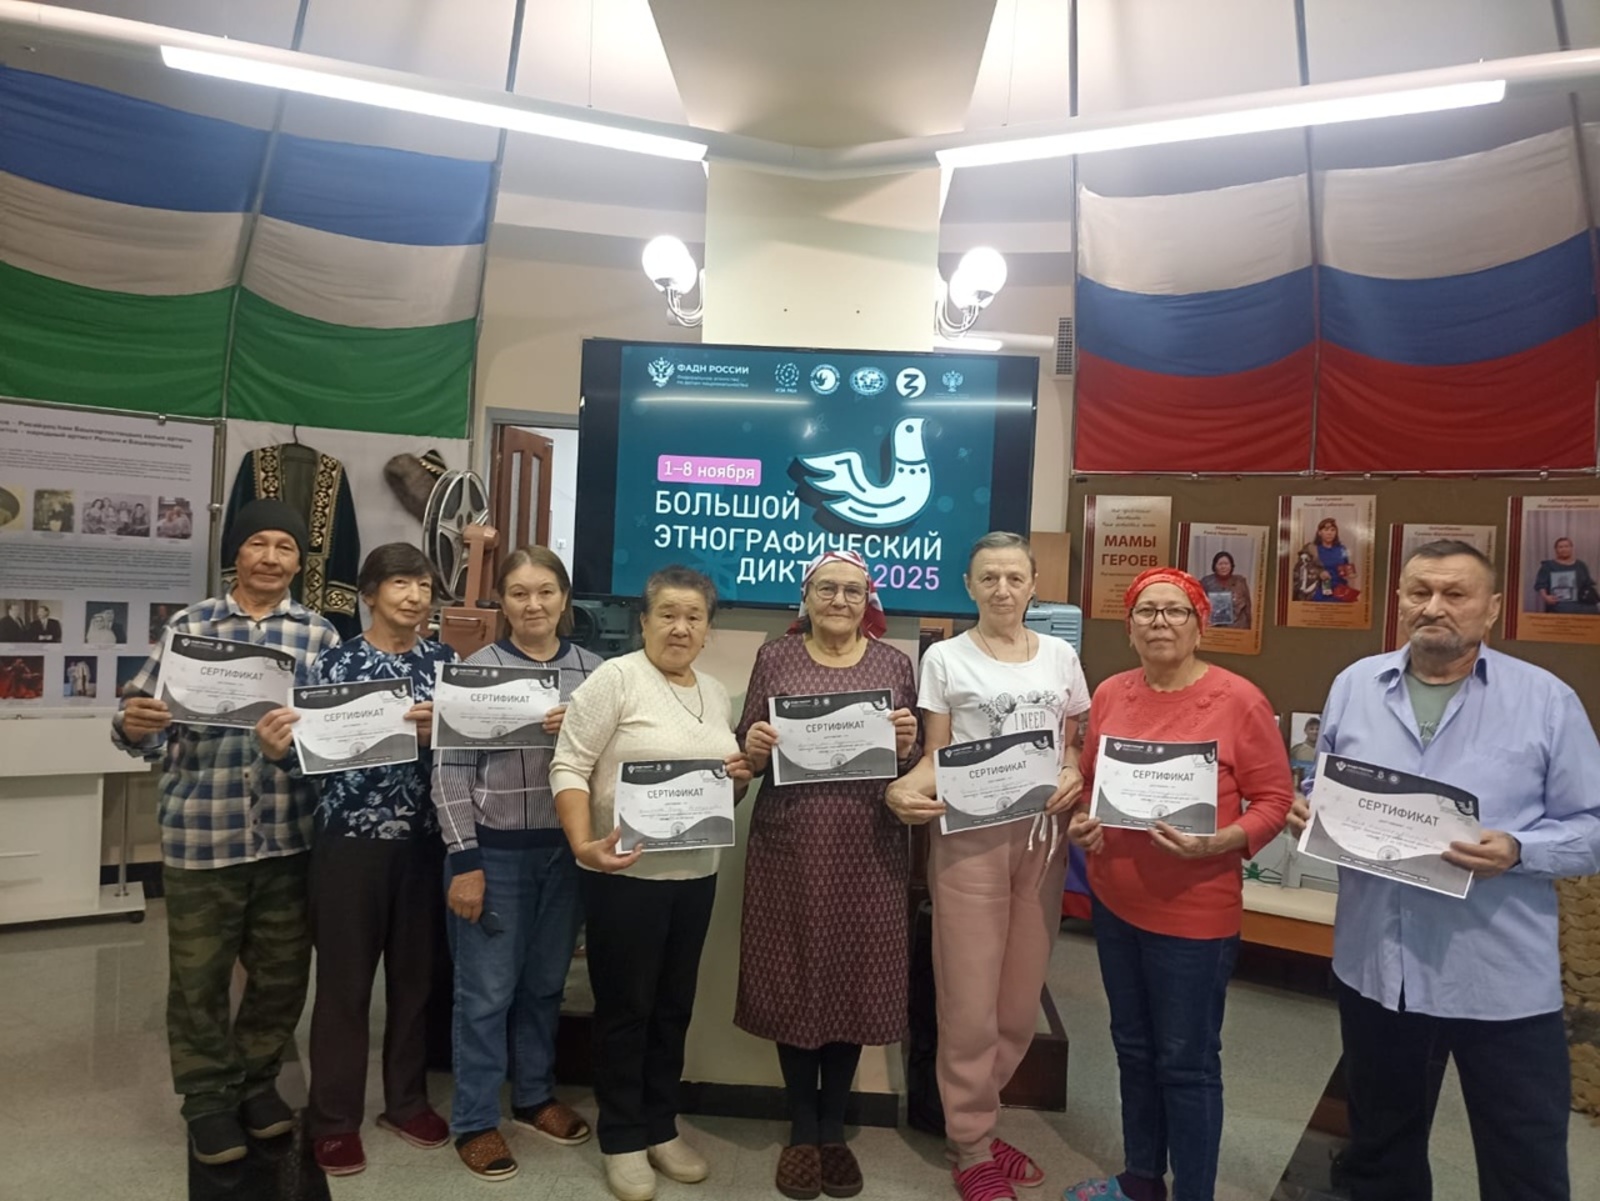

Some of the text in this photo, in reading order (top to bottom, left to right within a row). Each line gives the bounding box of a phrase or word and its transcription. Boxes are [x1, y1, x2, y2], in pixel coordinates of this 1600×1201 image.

[676, 364, 750, 375] ФАДН РОССИИ
[697, 463, 755, 483] ноября
[655, 490, 800, 521] БОЛЬШОЙ
[653, 523, 943, 561] ЭТНОГРАФИЧЕСКИЙ
[1104, 535, 1157, 548] МАМЫ
[1101, 553, 1158, 567] ГЕРОЕВ
[873, 563, 940, 591] 2025
[200, 666, 265, 681] СЕРТИФИКАТ
[470, 693, 531, 703] СЕРТИФИКАТ
[323, 707, 385, 722] СЕРТИФИКАТ
[1020, 711, 1046, 731] NEED
[805, 720, 865, 733] СЕРТИФИКАТ
[969, 760, 1028, 779] СЕРТИФИКАТ
[1132, 769, 1196, 782] СЕРТИФИКАТ
[647, 787, 704, 799] СЕРТИФИКАТ
[1357, 797, 1440, 827] СЕРТИФИКАТ
